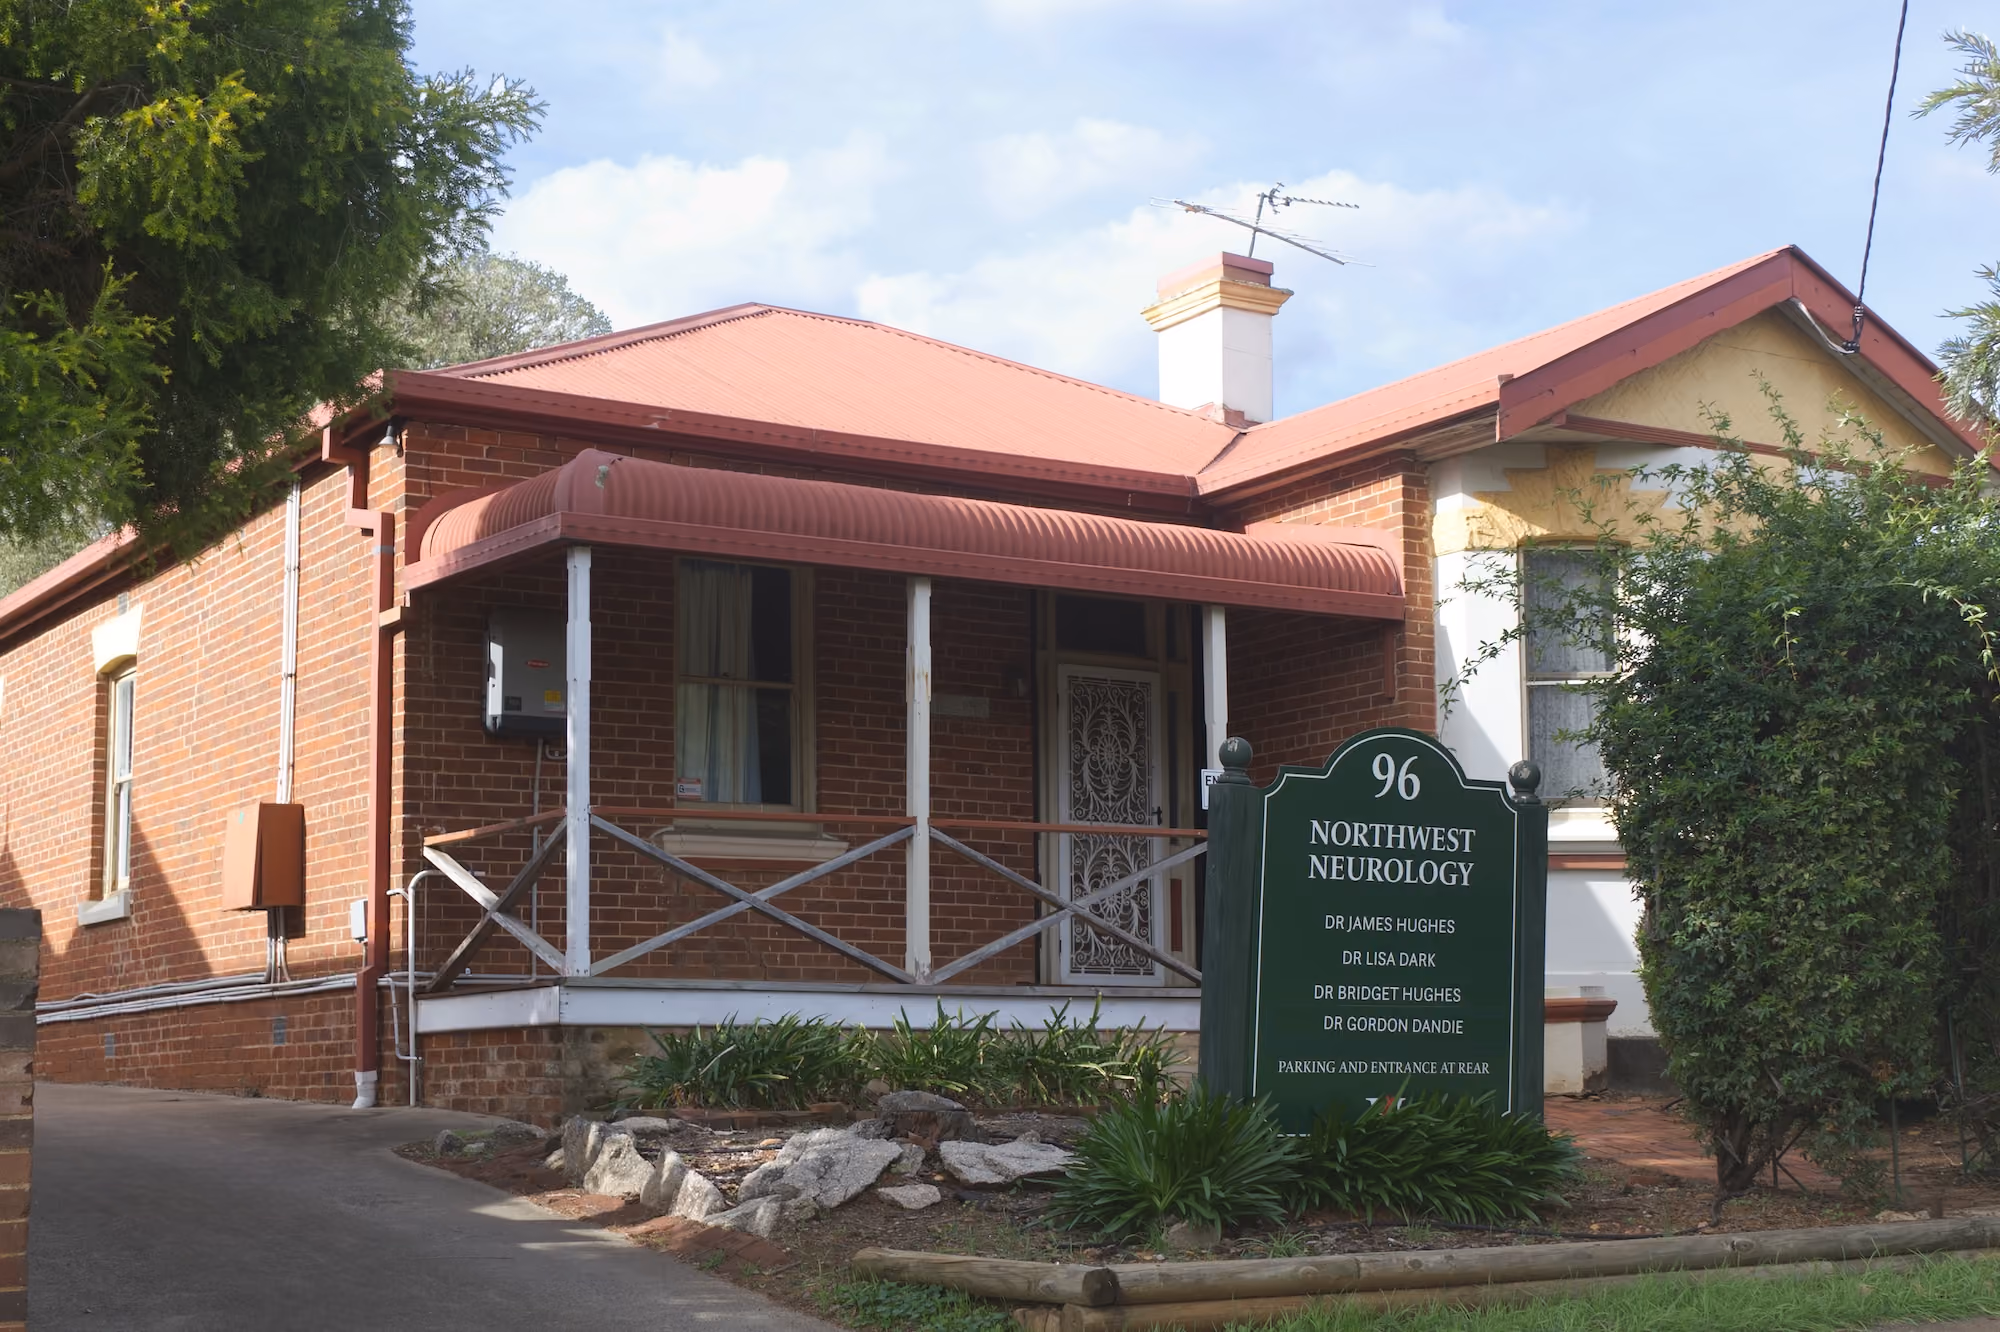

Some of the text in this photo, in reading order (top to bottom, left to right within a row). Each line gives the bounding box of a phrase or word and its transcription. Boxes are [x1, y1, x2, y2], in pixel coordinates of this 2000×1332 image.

[1372, 752, 1421, 801] 96
[1309, 819, 1476, 853] NORTHWEST
[1307, 854, 1475, 887] NEUROLOGY
[1325, 914, 1456, 934] DR JAMES HUGHES
[1342, 950, 1436, 968] DR LISA DARK
[1314, 984, 1462, 1003] DR BRIDGET HUGHES
[1323, 1015, 1464, 1035] DR GORDON DANDIE
[1278, 1060, 1490, 1075] PARKING AND ENTRANCE AT REAR
